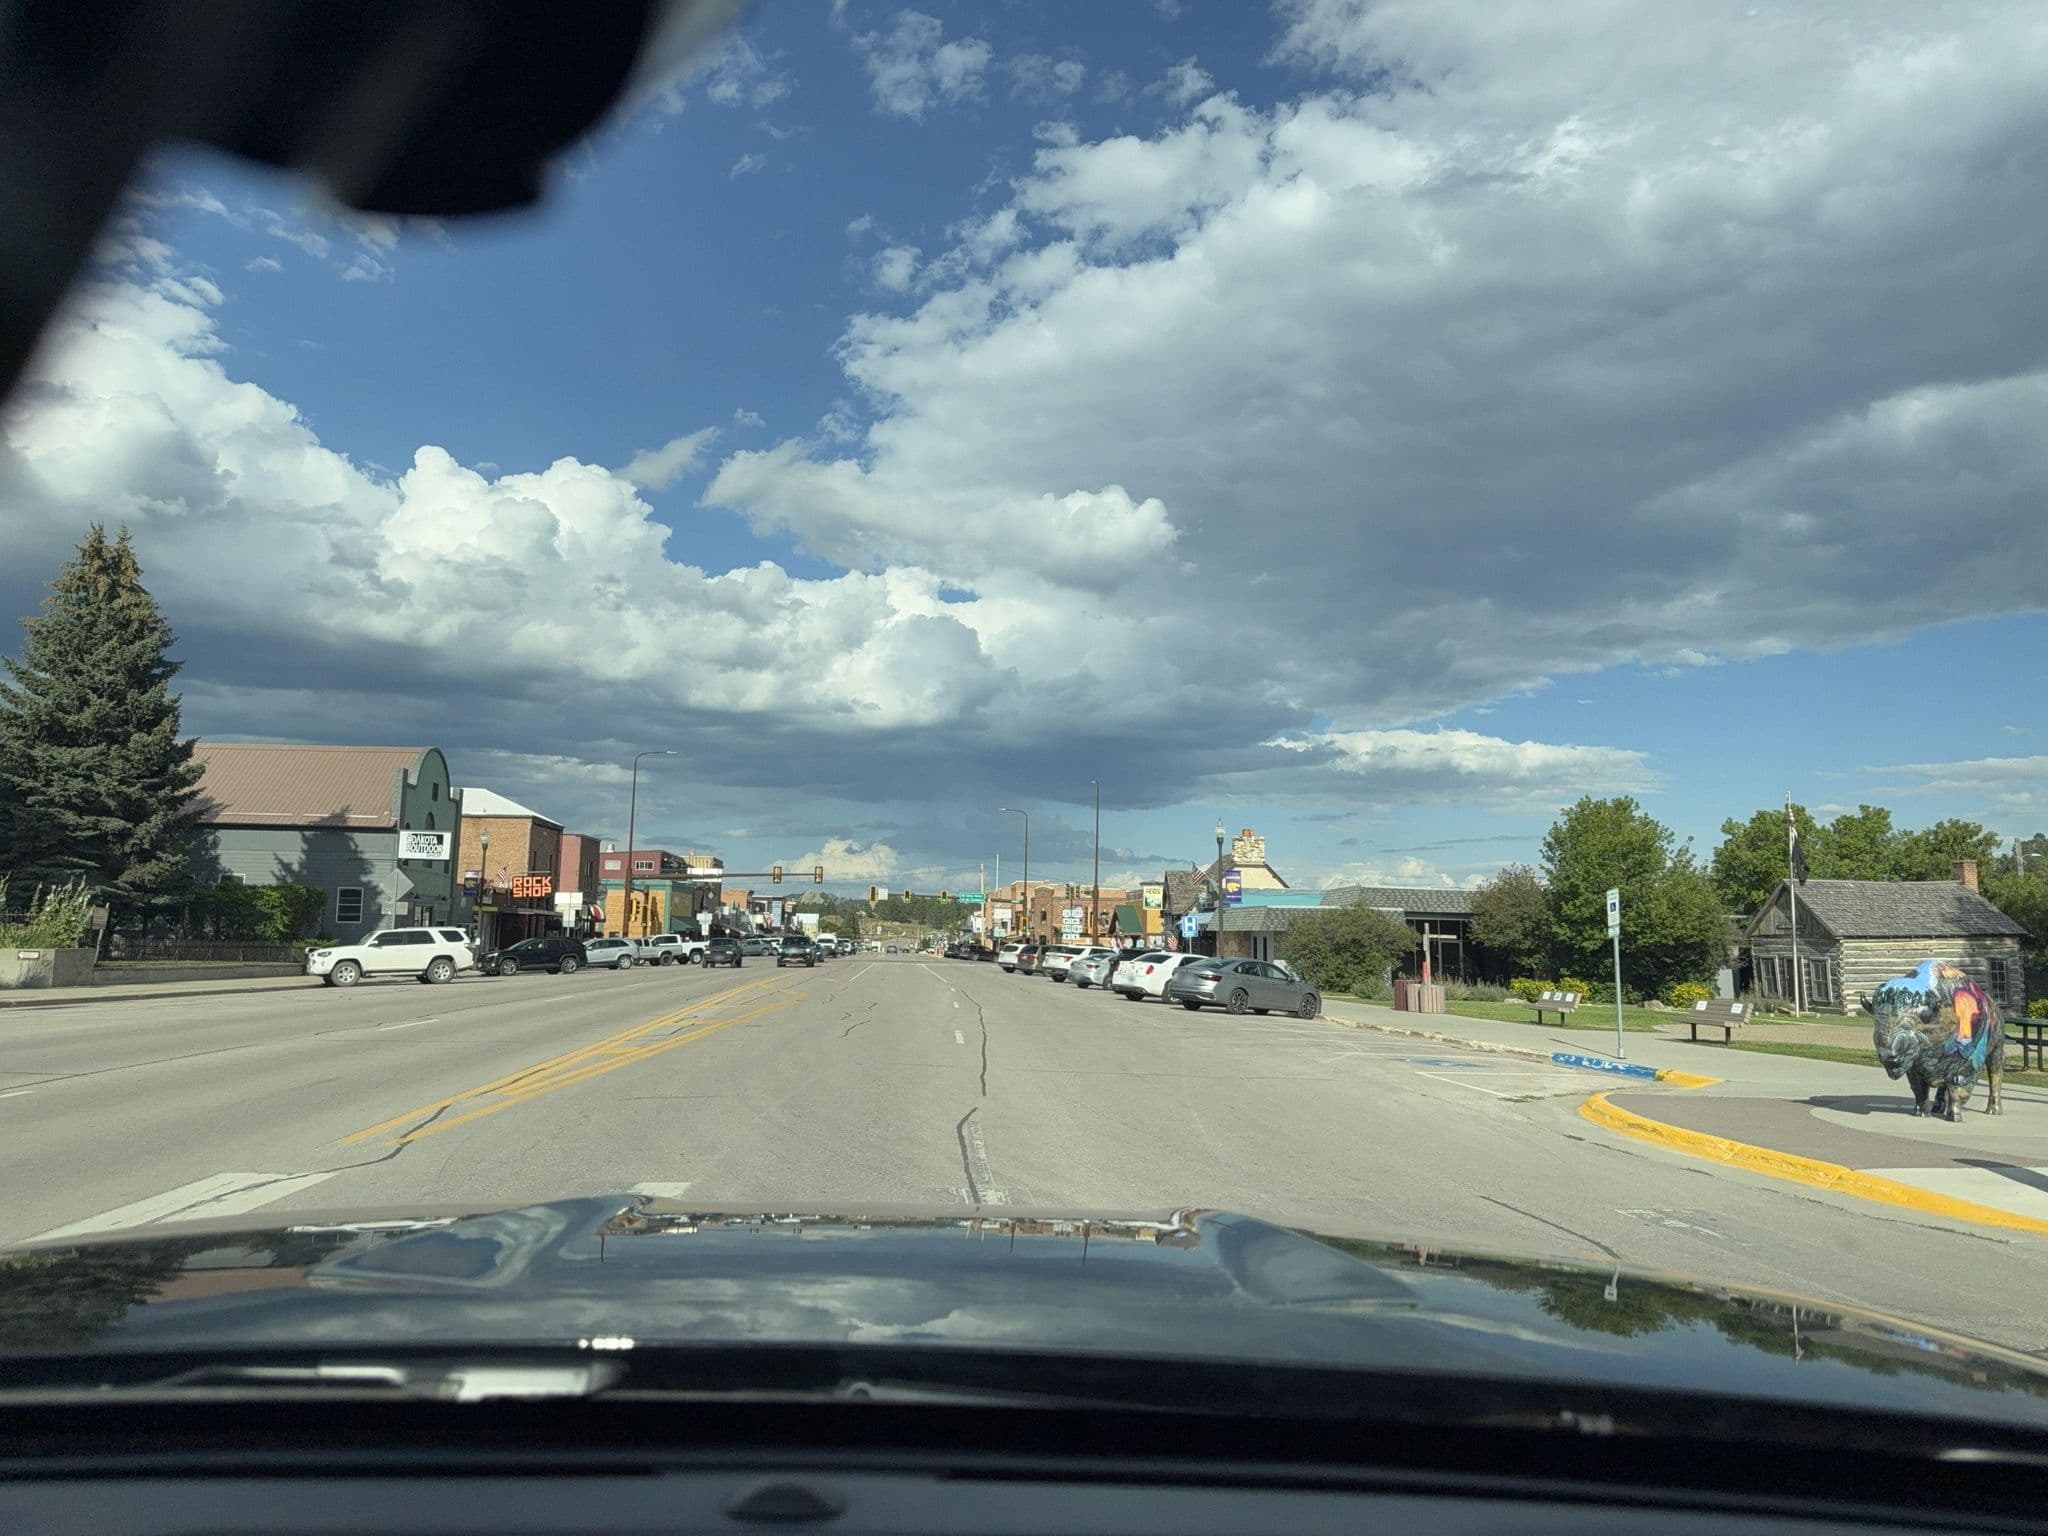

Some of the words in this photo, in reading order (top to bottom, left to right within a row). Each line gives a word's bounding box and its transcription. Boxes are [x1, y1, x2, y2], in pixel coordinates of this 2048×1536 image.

[411, 834, 437, 844] DAKOTA
[410, 844, 443, 853] OUTDOOR
[513, 876, 552, 887] ROCK
[513, 886, 552, 898] SHOP
[1184, 916, 1196, 932] H
